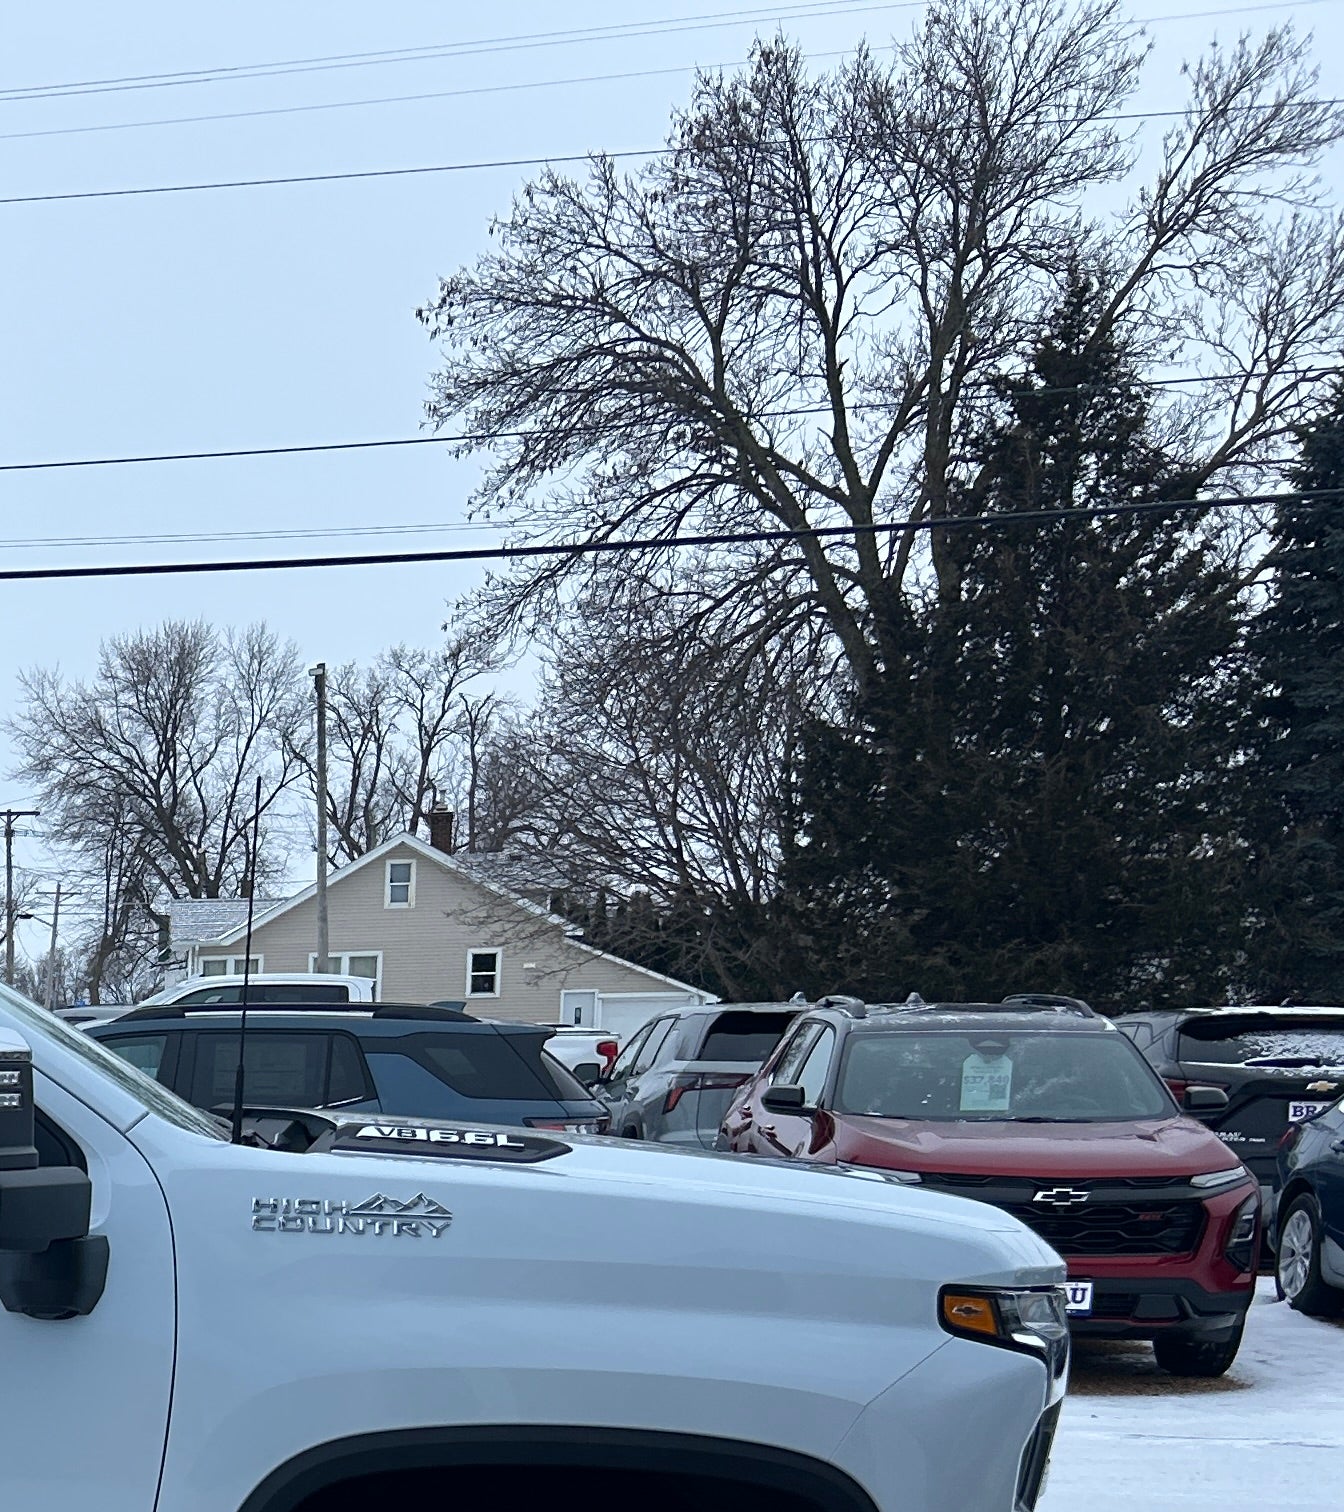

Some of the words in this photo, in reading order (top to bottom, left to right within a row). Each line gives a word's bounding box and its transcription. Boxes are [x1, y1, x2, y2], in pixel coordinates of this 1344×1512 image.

[371, 1126, 420, 1139] V8
[429, 1129, 525, 1147] 6.6L
[251, 1197, 349, 1215] HIGH
[251, 1215, 452, 1238] COUNTRY
